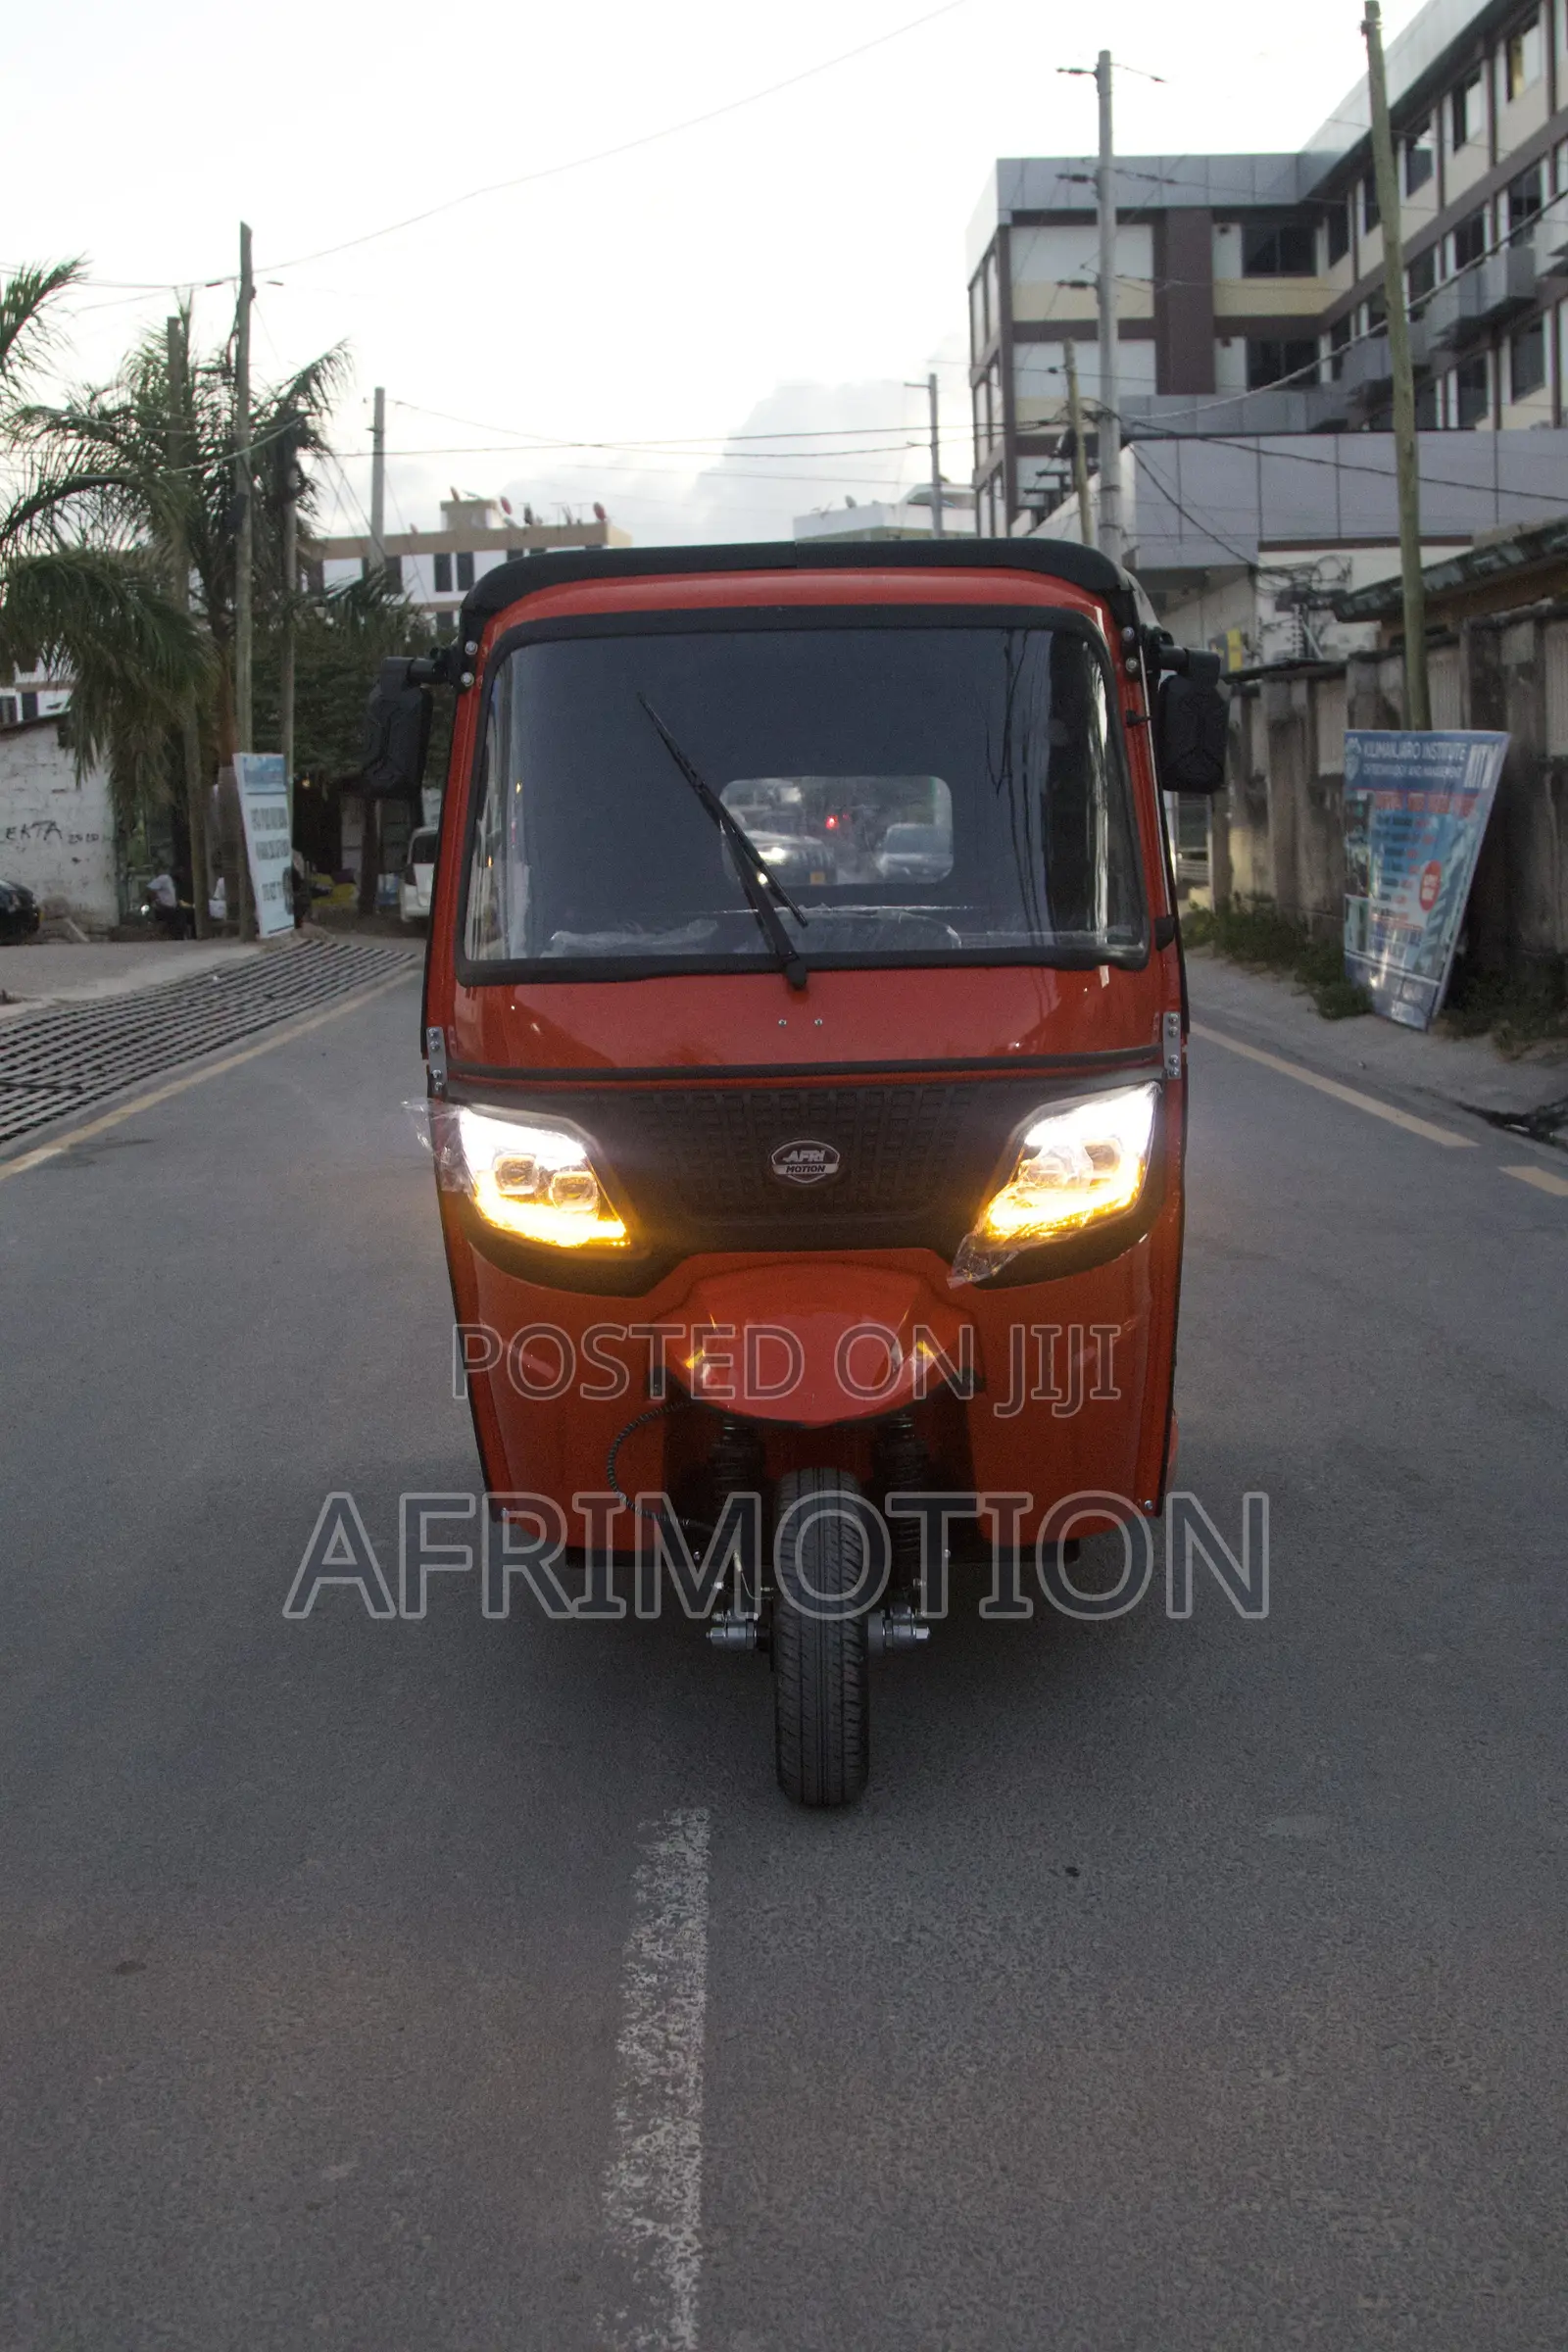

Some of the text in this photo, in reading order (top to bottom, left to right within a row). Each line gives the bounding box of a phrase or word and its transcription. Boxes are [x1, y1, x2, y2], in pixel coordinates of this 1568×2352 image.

[1422, 742, 1467, 761] INSTITUTE
[782, 1150, 826, 1162] AFRI
[786, 1164, 826, 1173] MOTION
